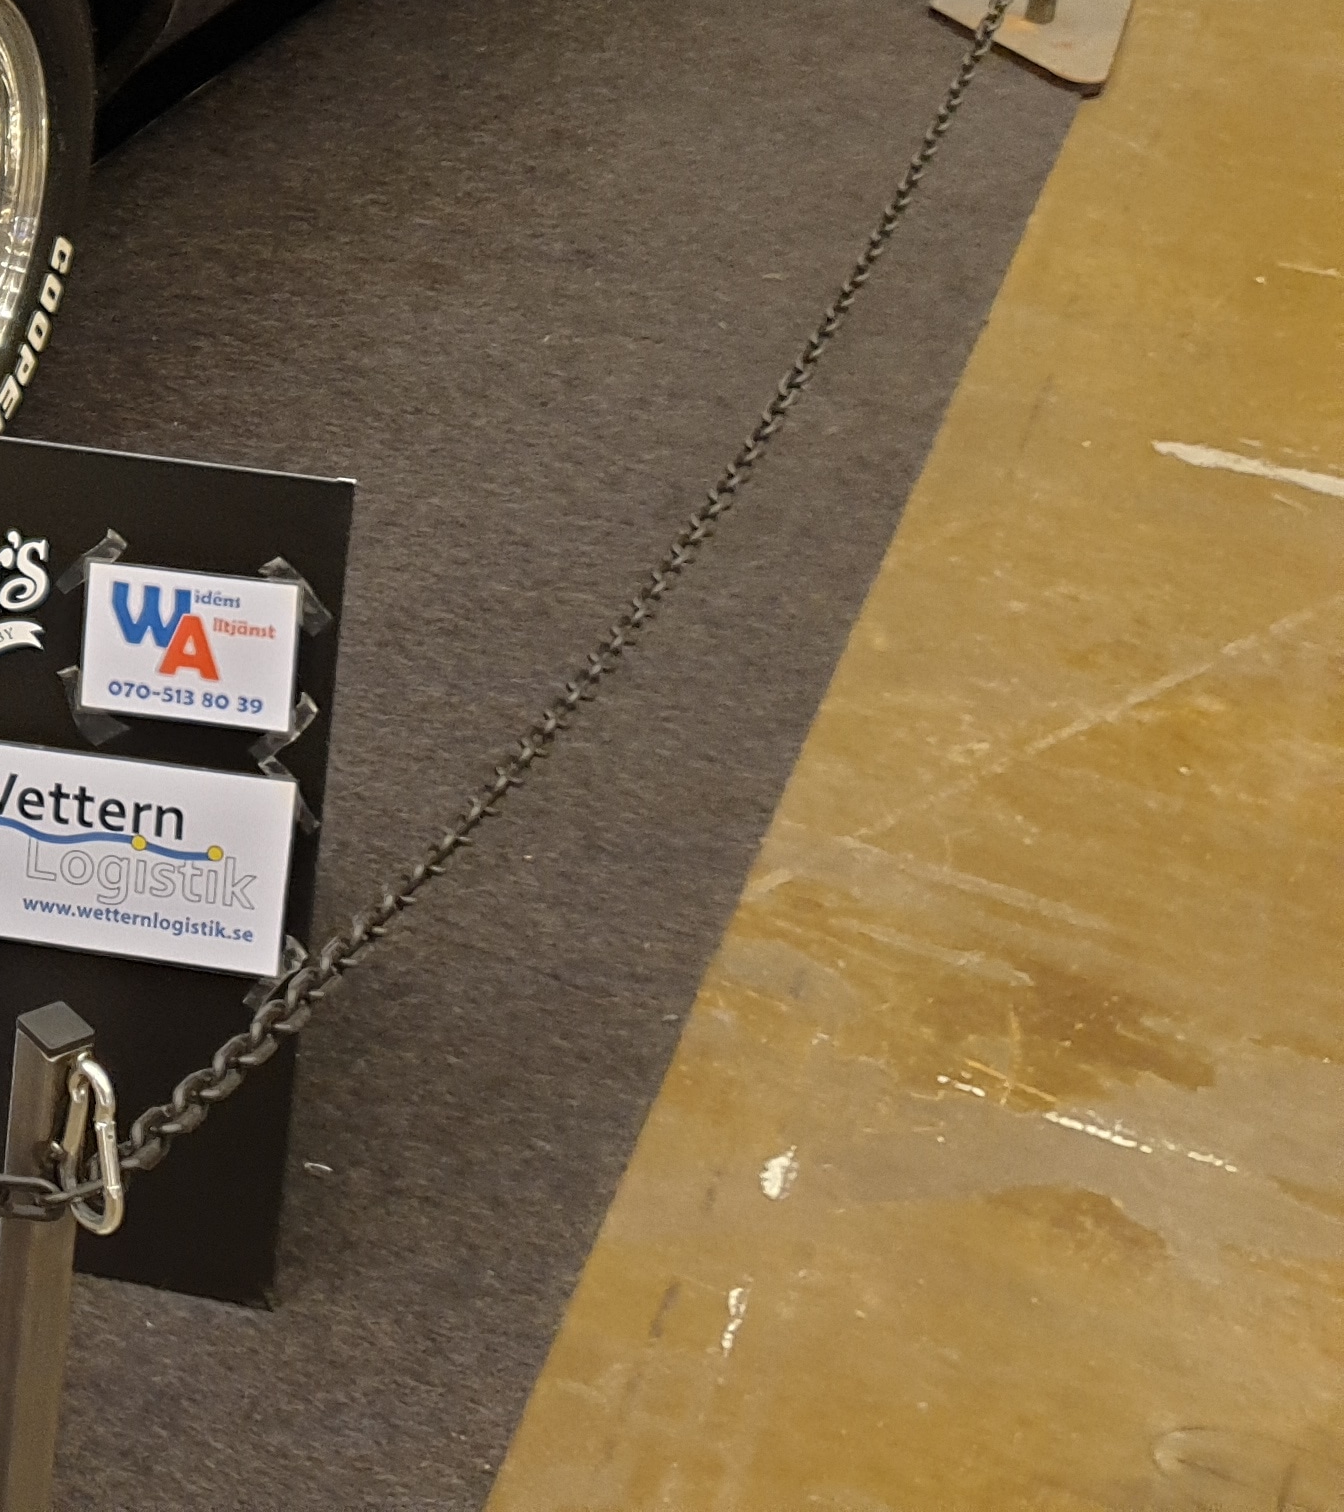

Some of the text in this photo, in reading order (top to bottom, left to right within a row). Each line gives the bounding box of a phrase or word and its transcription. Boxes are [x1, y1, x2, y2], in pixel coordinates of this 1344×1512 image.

[106, 678, 264, 715] 070-513 80 39
[26, 836, 257, 910] Logistik
[21, 897, 253, 942] www.wetternlogistik.se
